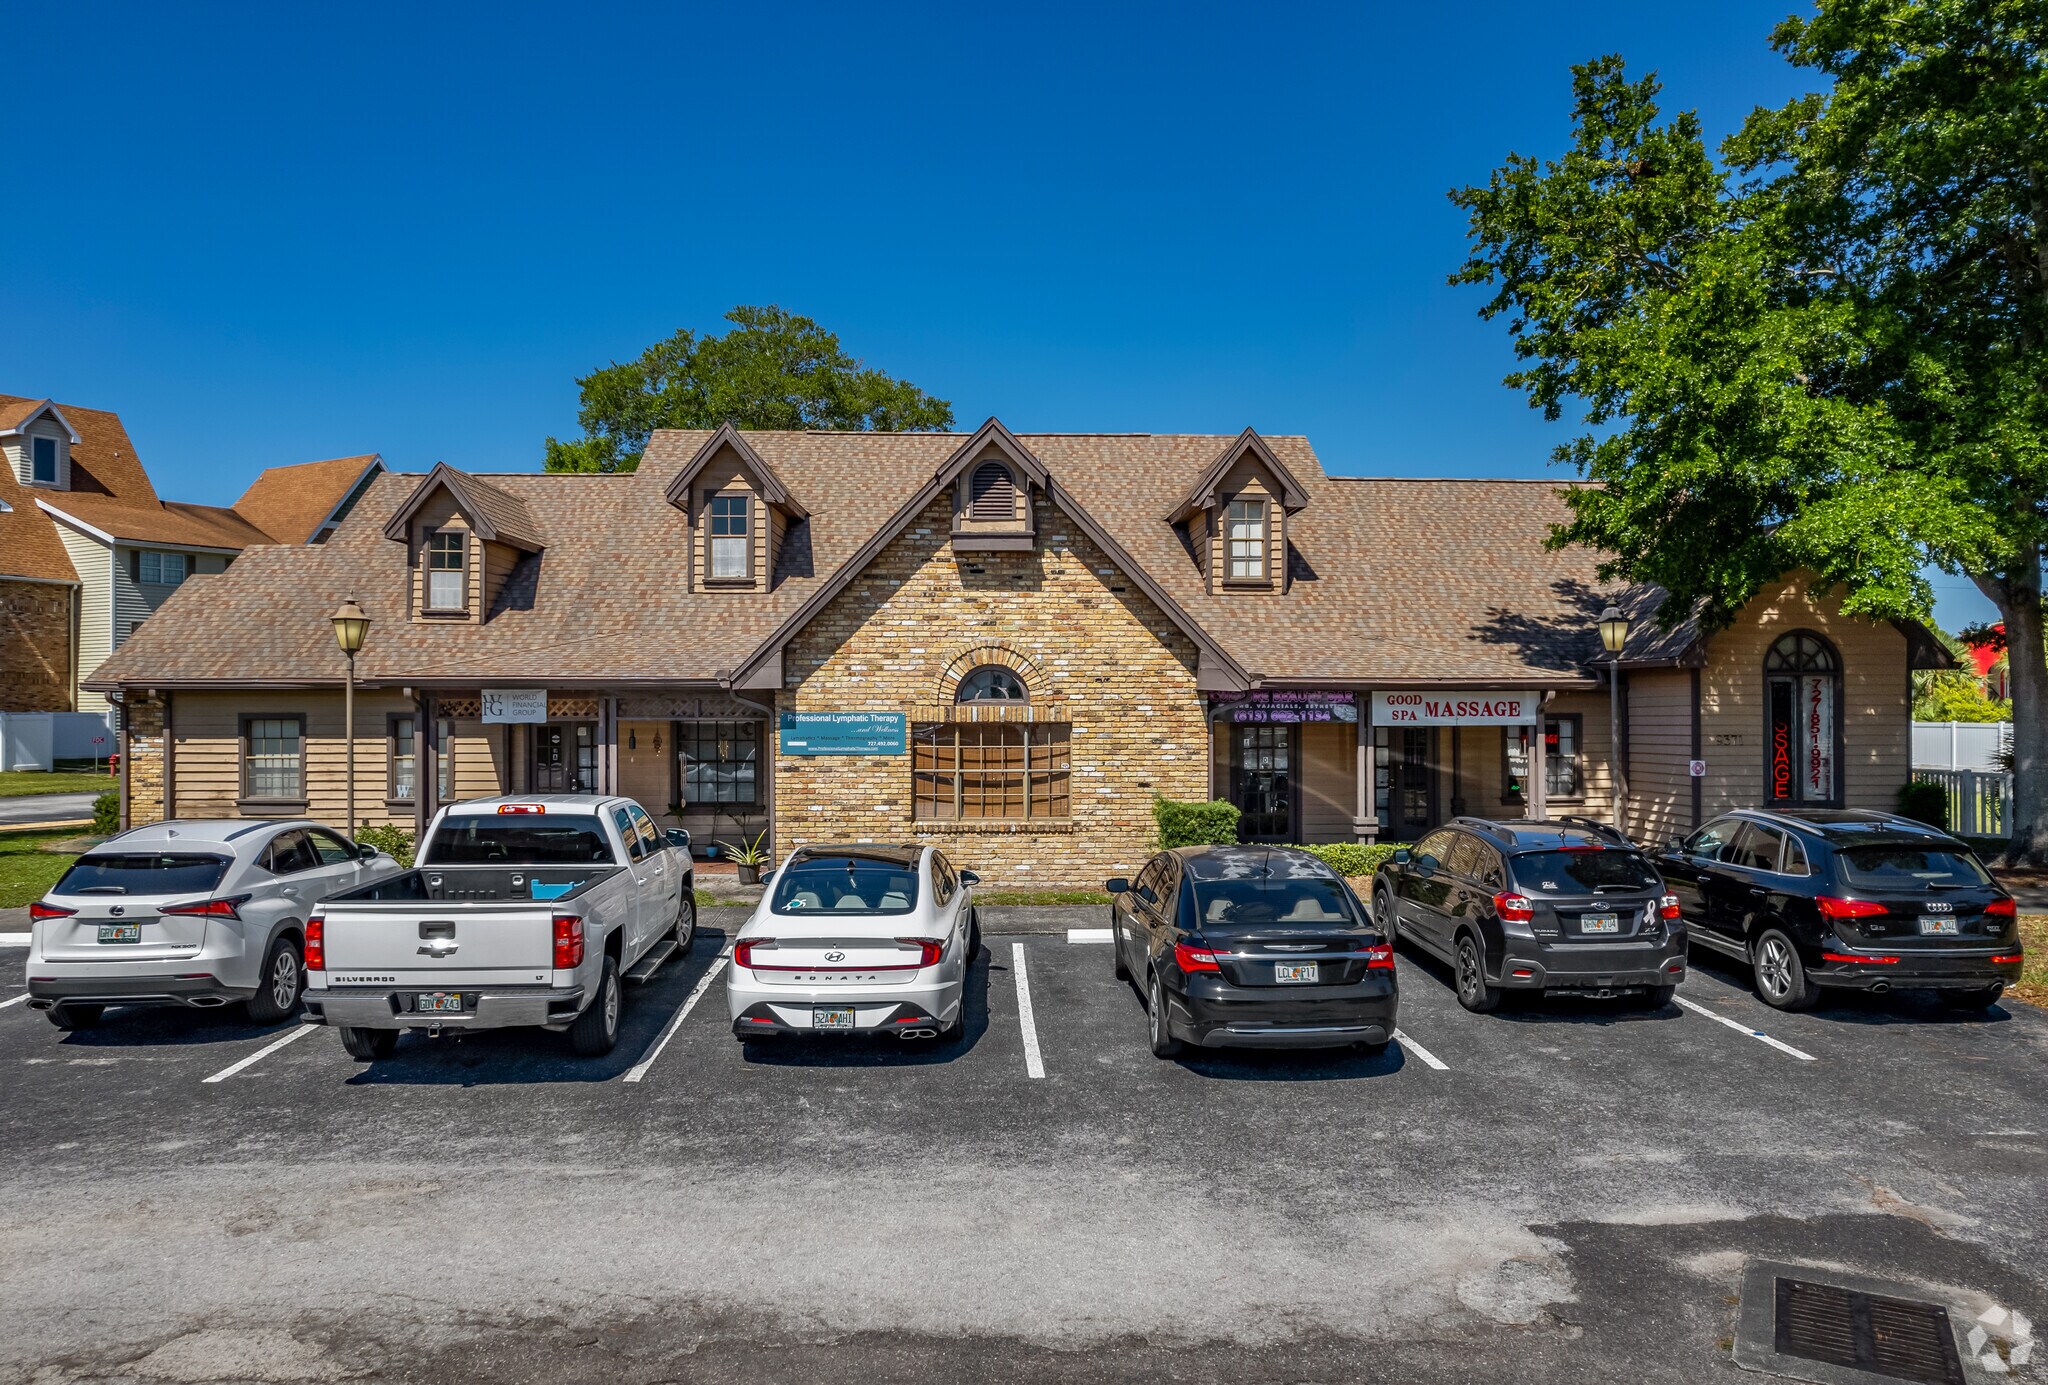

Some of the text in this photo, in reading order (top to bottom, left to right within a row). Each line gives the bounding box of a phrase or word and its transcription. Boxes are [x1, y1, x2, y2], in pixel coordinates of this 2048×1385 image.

[1272, 690, 1322, 703] BEAUTY
[1327, 690, 1355, 703] BAR
[1386, 694, 1423, 705] GOOD
[1424, 701, 1521, 717] MASSAGE
[787, 714, 899, 723] Professional Lymphatic Therapy
[1391, 710, 1418, 721] SPA
